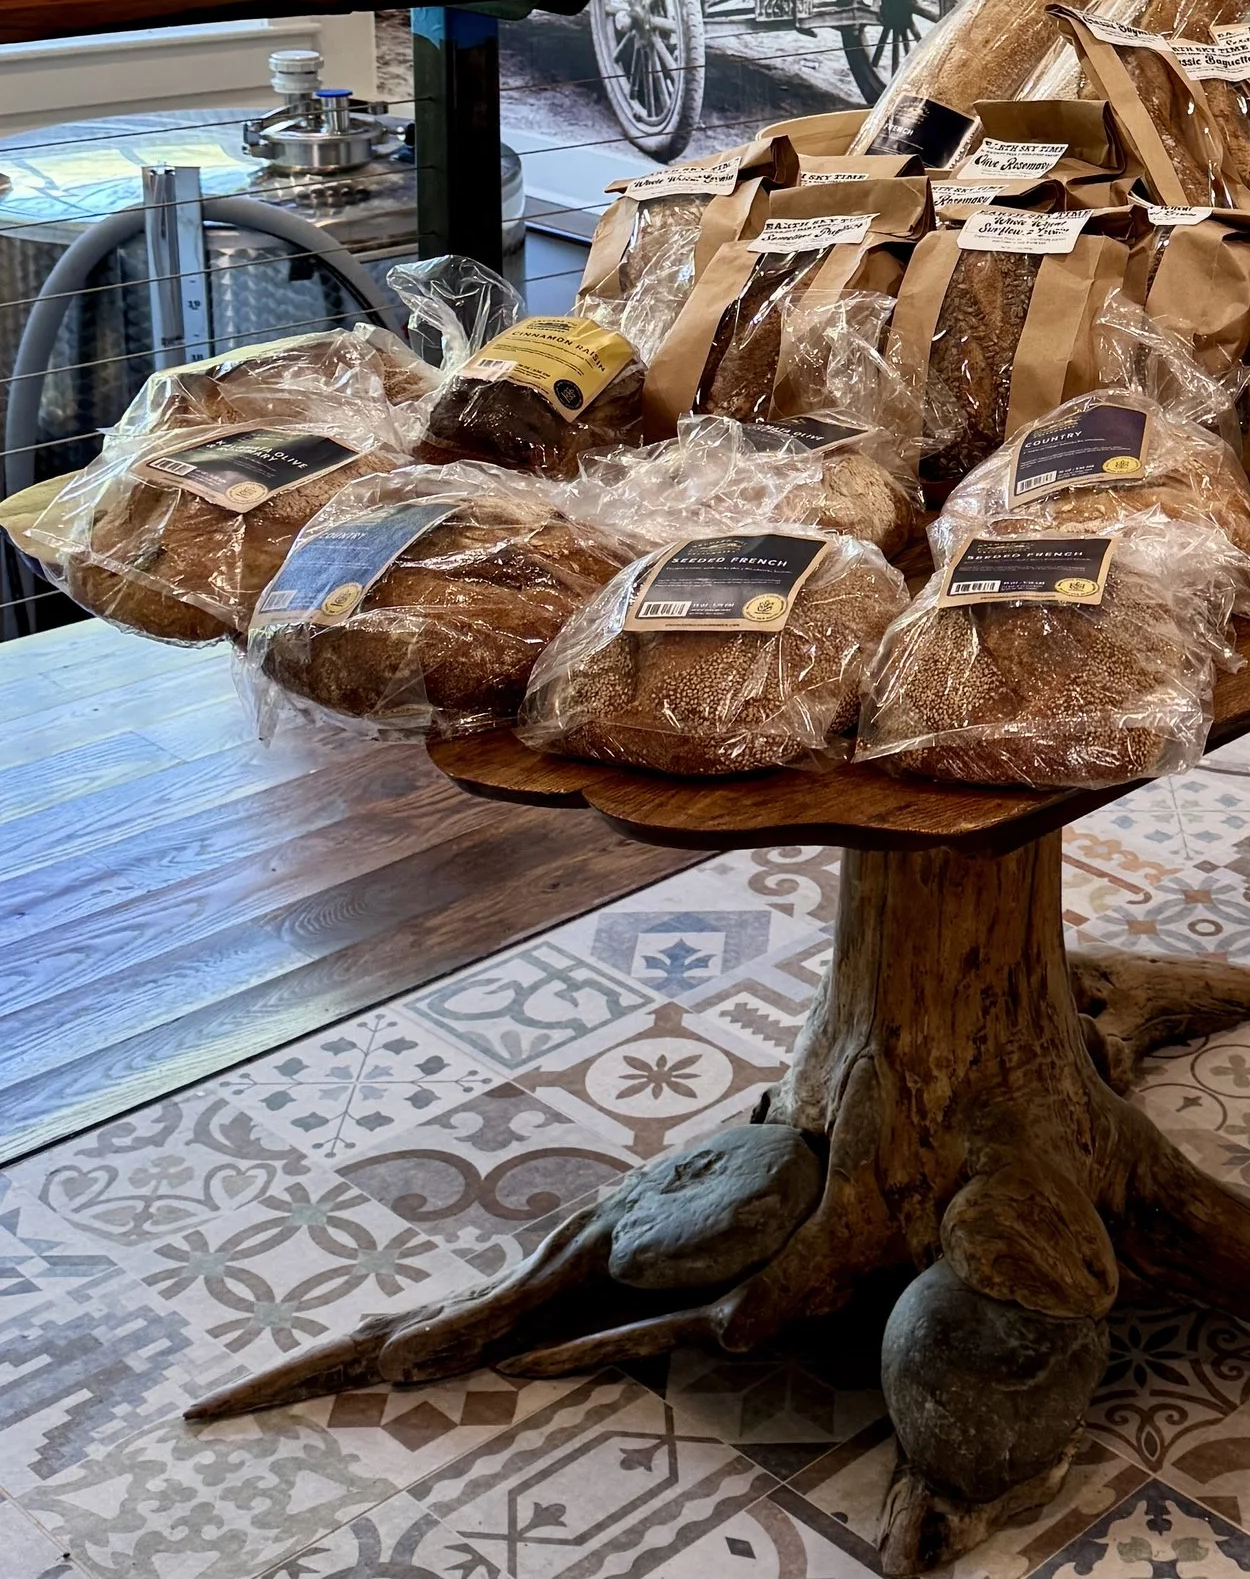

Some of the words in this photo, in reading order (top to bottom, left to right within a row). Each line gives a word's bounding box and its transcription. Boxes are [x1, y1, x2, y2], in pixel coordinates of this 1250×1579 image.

[1217, 45, 1249, 54] TIME
[1019, 144, 1038, 152] SKY
[1039, 145, 1065, 153] TIME
[974, 154, 1000, 168] Olive
[1000, 157, 1053, 172] Rosemary
[512, 331, 573, 346] CINNAMON
[576, 342, 606, 373] RAISIN
[1024, 430, 1083, 449] COUNTRY
[274, 451, 309, 469] OLIVE
[671, 556, 725, 564] SEEDED
[730, 556, 788, 568] FRENCH
[1026, 550, 1084, 559] FRENCH
